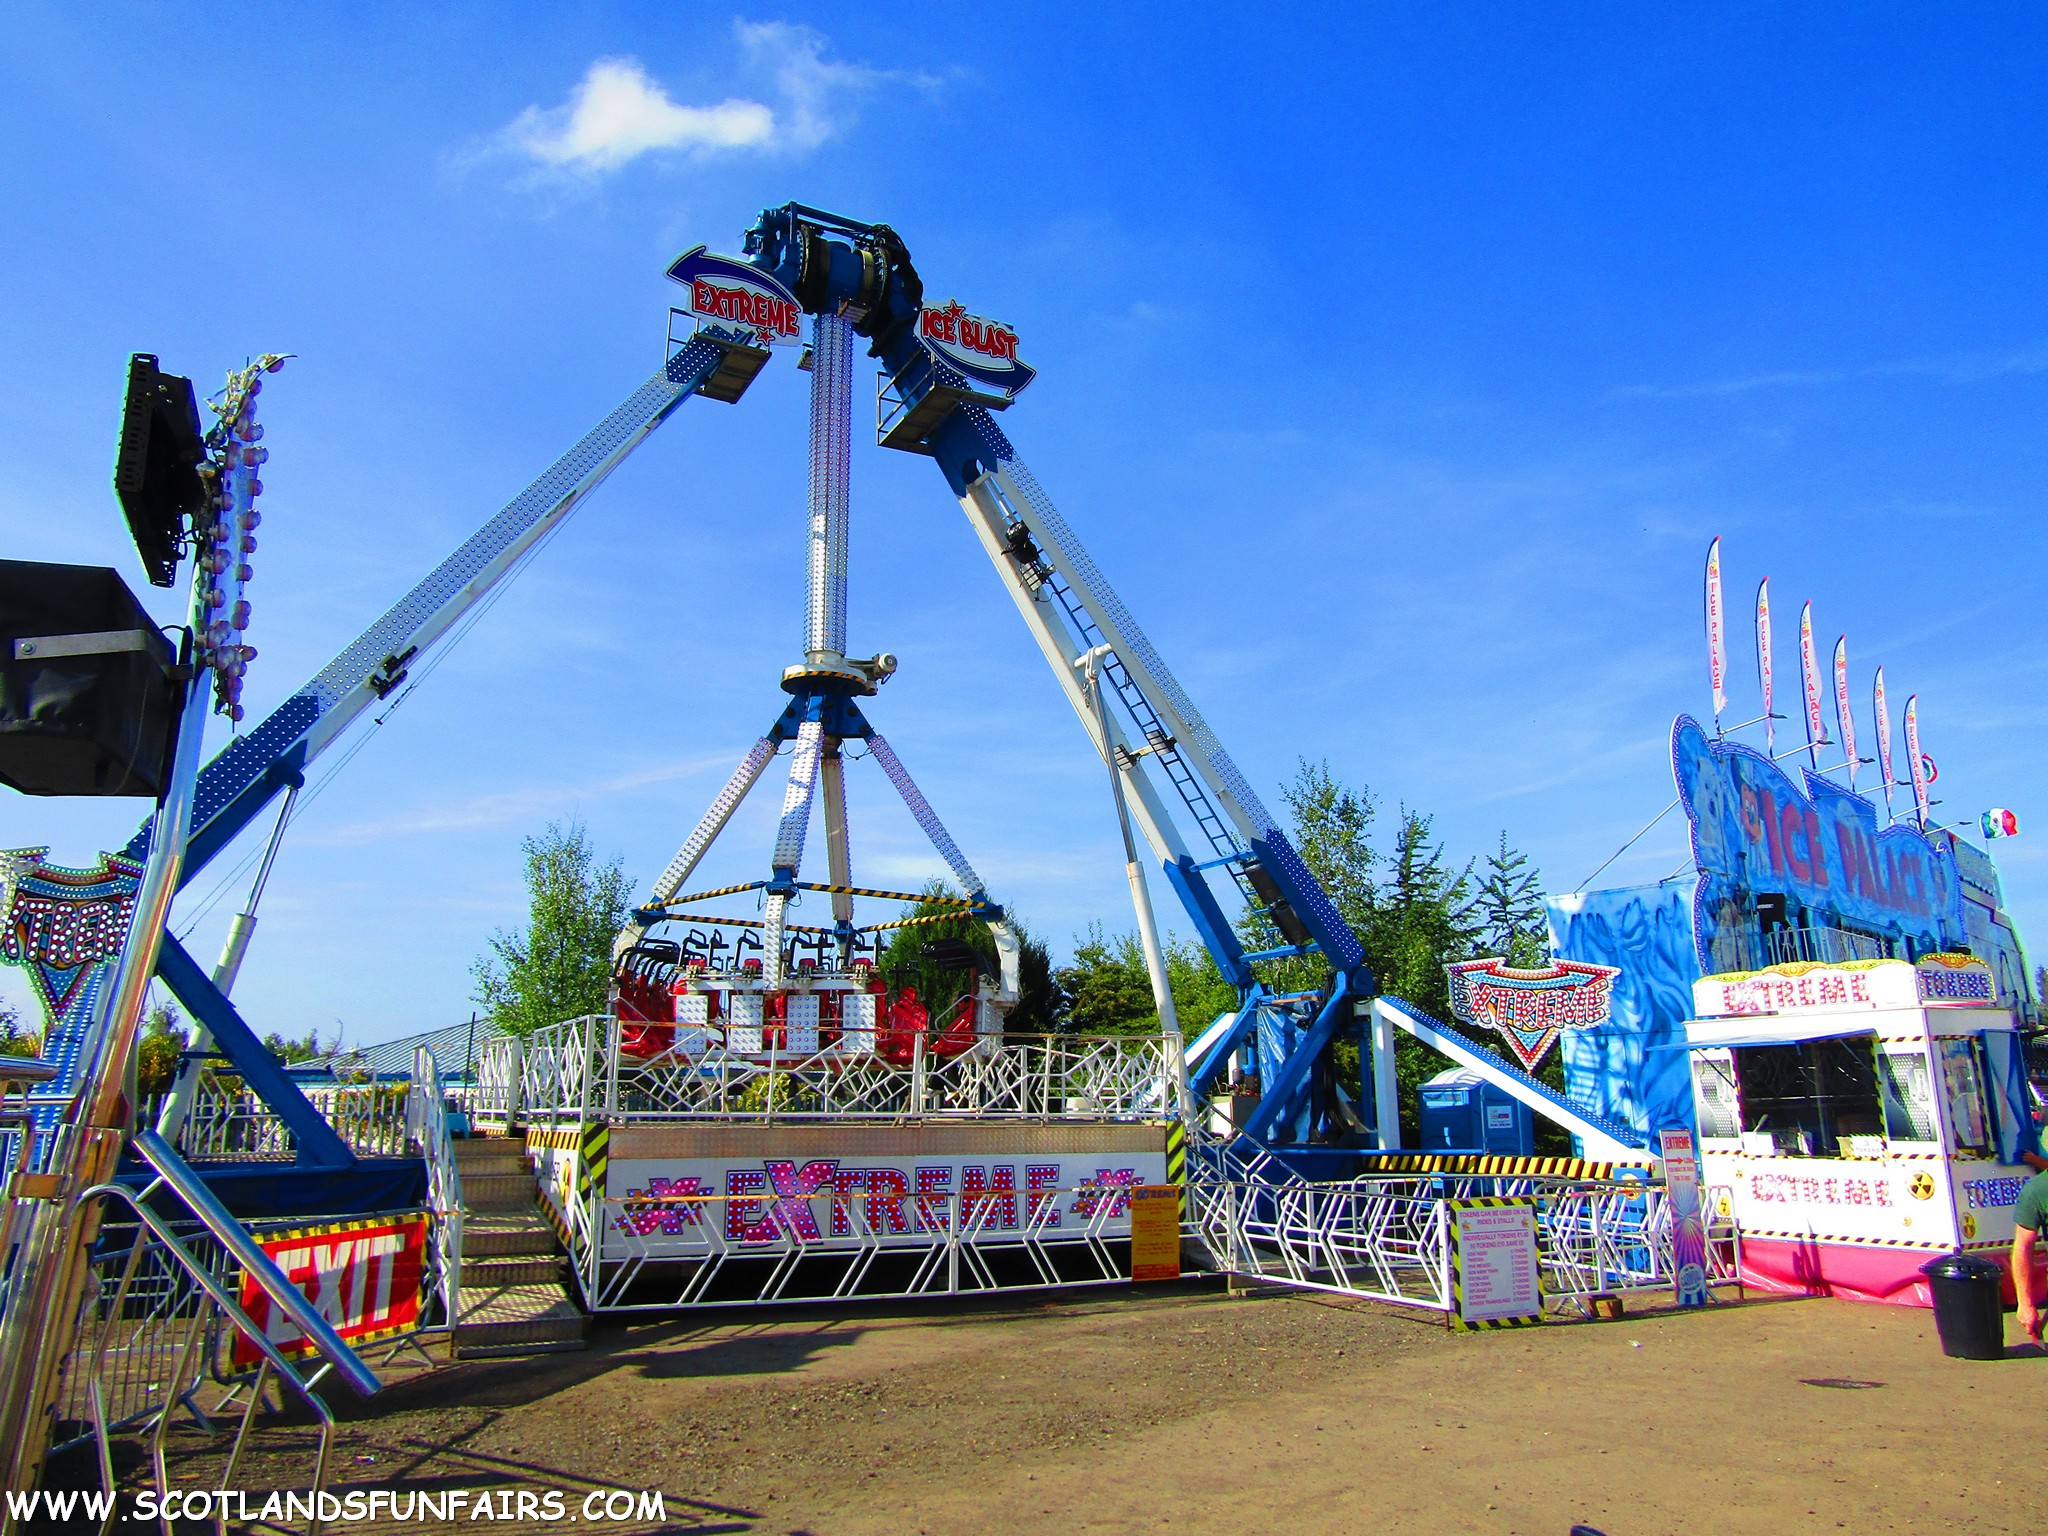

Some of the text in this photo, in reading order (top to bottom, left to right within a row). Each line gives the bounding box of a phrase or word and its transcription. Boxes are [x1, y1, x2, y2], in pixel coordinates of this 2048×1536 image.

[692, 280, 801, 337] EXTREME
[921, 308, 1020, 360] ICE BLAST
[1709, 582, 1721, 689] ICE PALACE
[1911, 753, 1925, 801] PALACE
[1760, 788, 1829, 886] ICE
[1451, 977, 1609, 1030] EXTREME
[1721, 973, 1870, 1013] EXTREME
[1921, 969, 1991, 999] TOKENS
[1664, 1135, 1691, 1149] EXTREME
[726, 1160, 1060, 1248] EXTREME
[1750, 1174, 1893, 1207] EXTREME
[1962, 1176, 2031, 1208] TOKEN
[265, 1233, 405, 1345] EXIT
